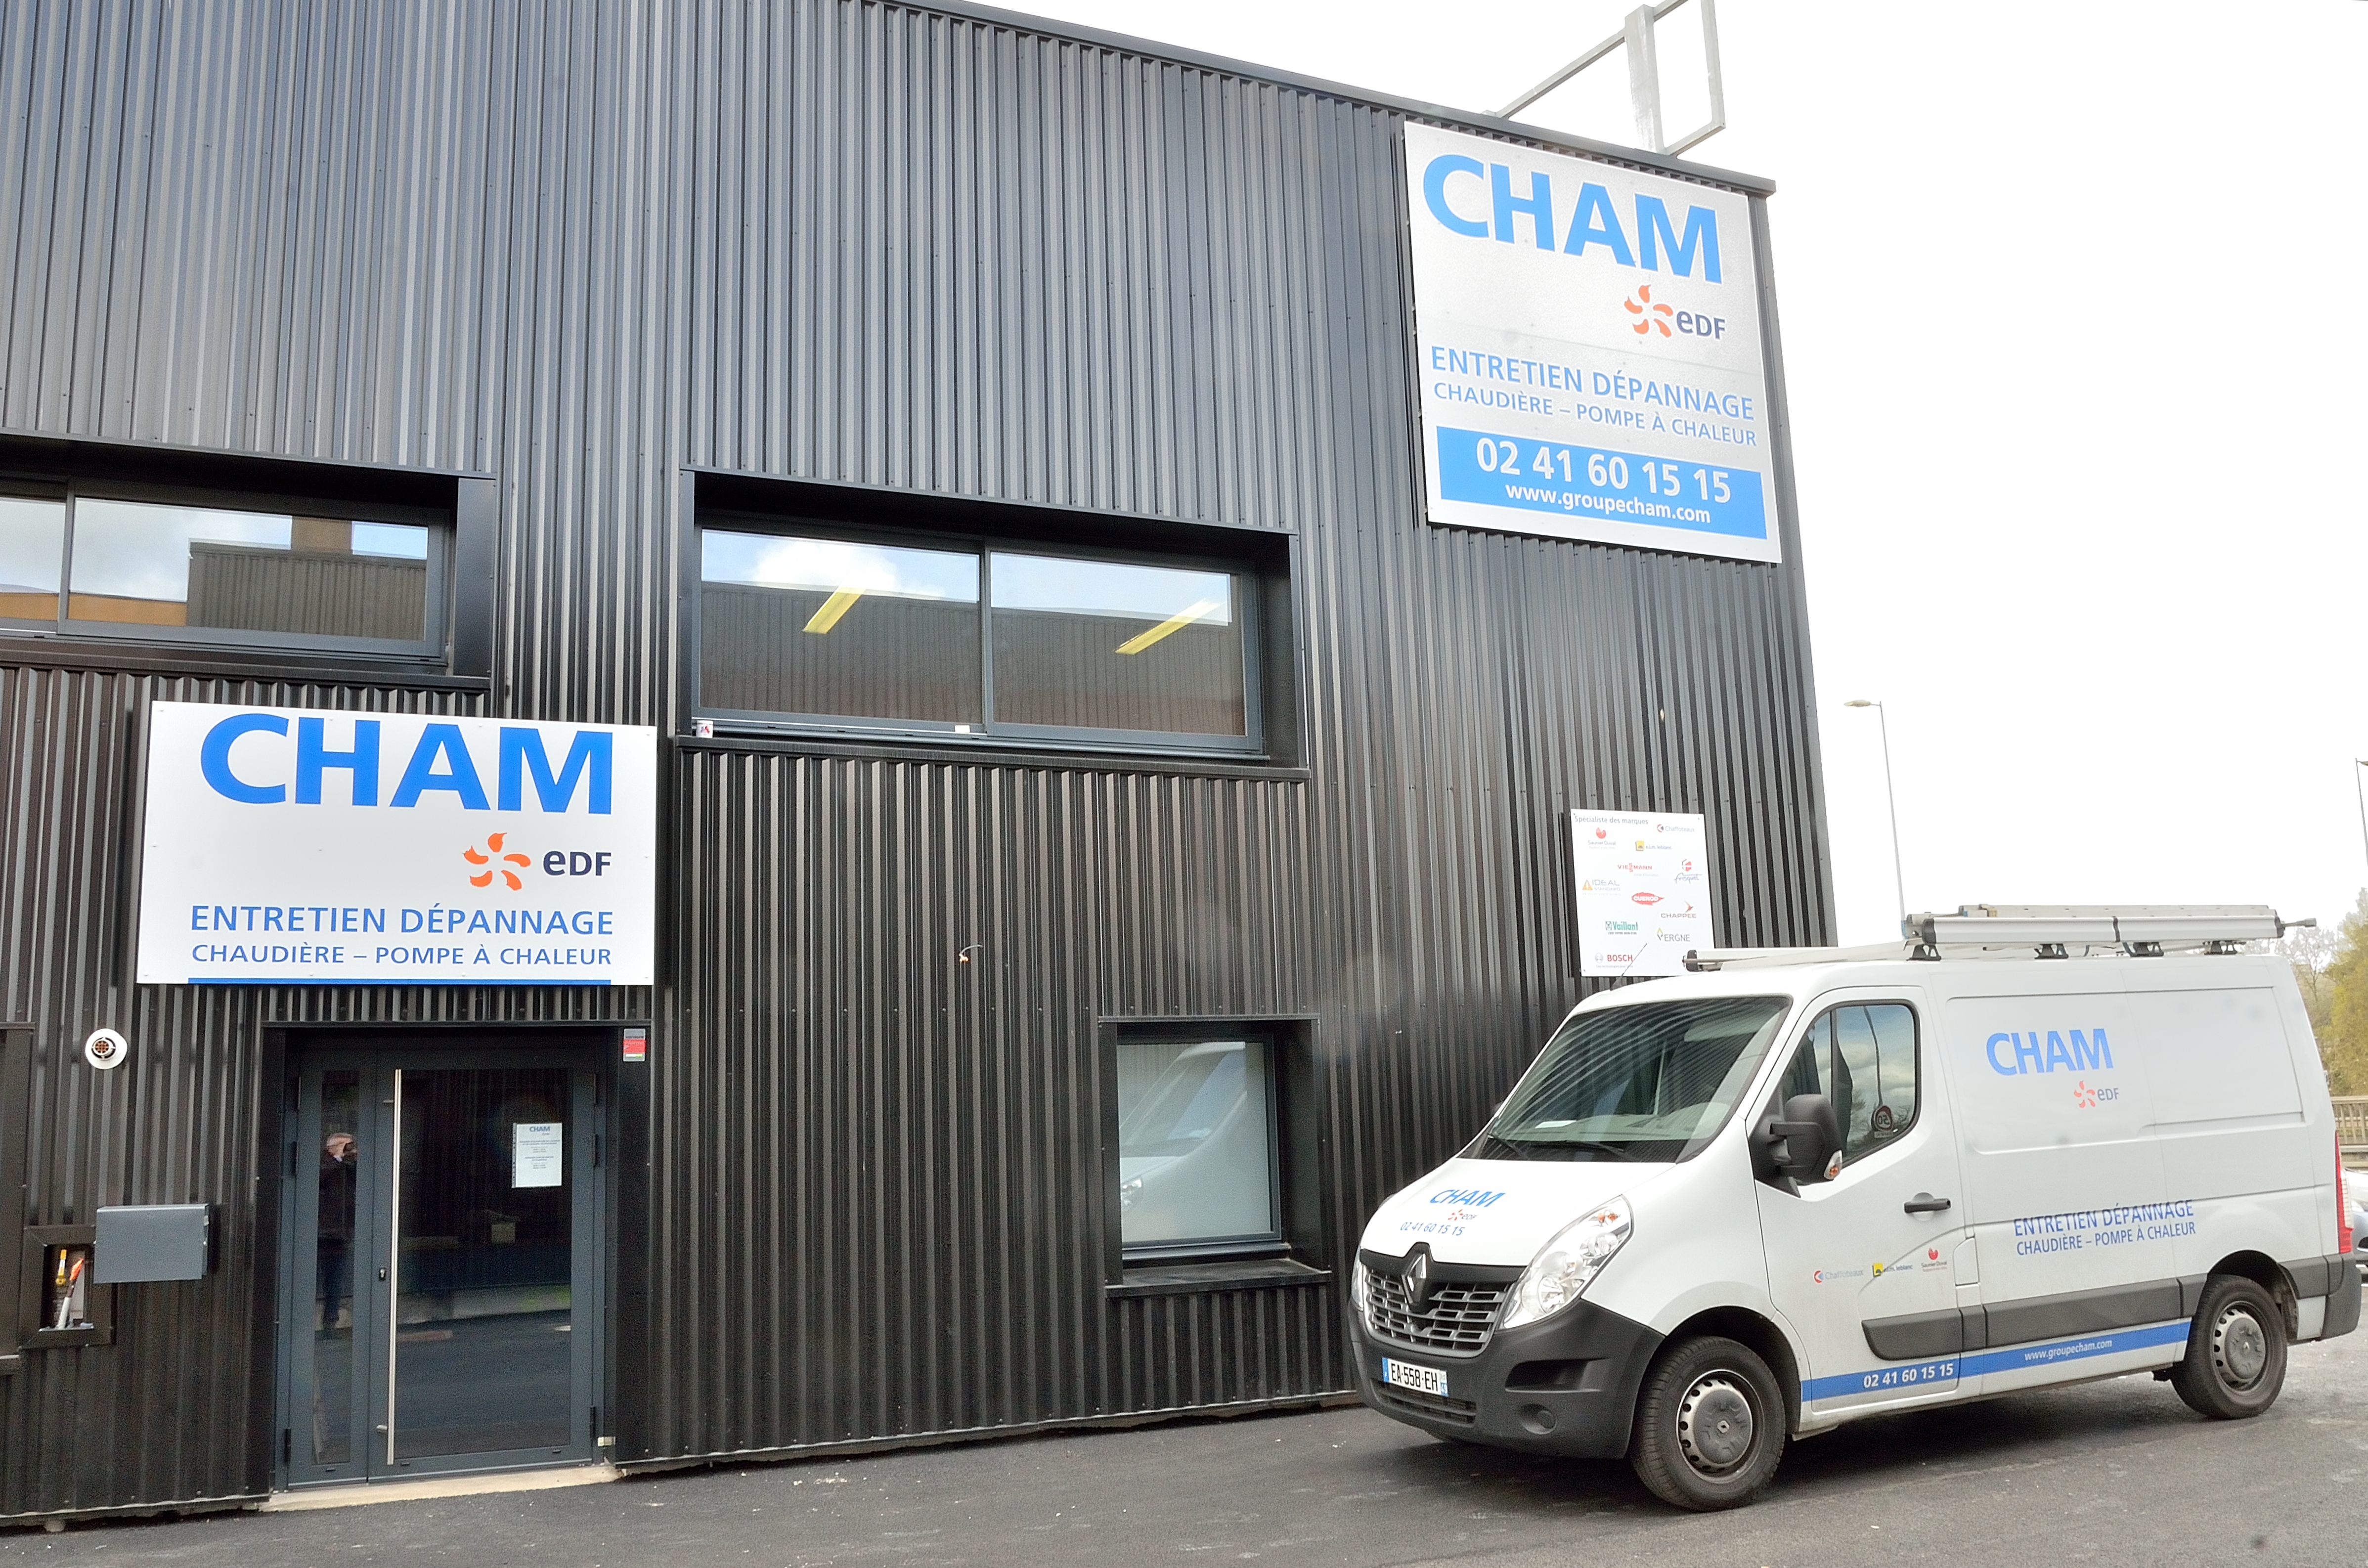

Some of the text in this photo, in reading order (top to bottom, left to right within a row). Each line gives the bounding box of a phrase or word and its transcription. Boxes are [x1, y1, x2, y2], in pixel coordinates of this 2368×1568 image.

[1422, 154, 1723, 285] CHAM
[1431, 346, 1754, 421] ENTRETIEN DÉPANNAGE
[1434, 382, 1553, 416] CHAUDIÈRE
[1577, 404, 1646, 430] POMPE
[1652, 410, 1666, 433] À
[1671, 418, 1757, 447] CHALEUR
[1476, 437, 1732, 504] 02 41 60 15 15
[1505, 483, 1711, 524] www.groupecham.com
[200, 712, 614, 815] CHAM
[191, 903, 614, 936] ENTRETIEN DÉPANNAGE
[1612, 921, 1639, 931] Vaillant
[191, 941, 345, 963] CHAUDIÈRE
[375, 947, 464, 965] POMPE
[473, 943, 491, 965] À
[499, 948, 612, 966] CHALEUR
[1985, 1028, 2114, 1076] CHAM
[1430, 1189, 1506, 1207] CHAM
[1400, 1222, 1465, 1236] 02 41 60 15 15
[2014, 1199, 2194, 1237] ENTRETIEN DÉPANNAGE
[2017, 1234, 2083, 1256] CHAUDIÈRE
[2095, 1227, 2134, 1247] POMPE
[2137, 1225, 2146, 1242] À
[2148, 1221, 2196, 1240] CHALEUR
[2025, 1340, 2112, 1361] www.groupecham.com
[1863, 1363, 1954, 1388] 02 41 60 15 15
